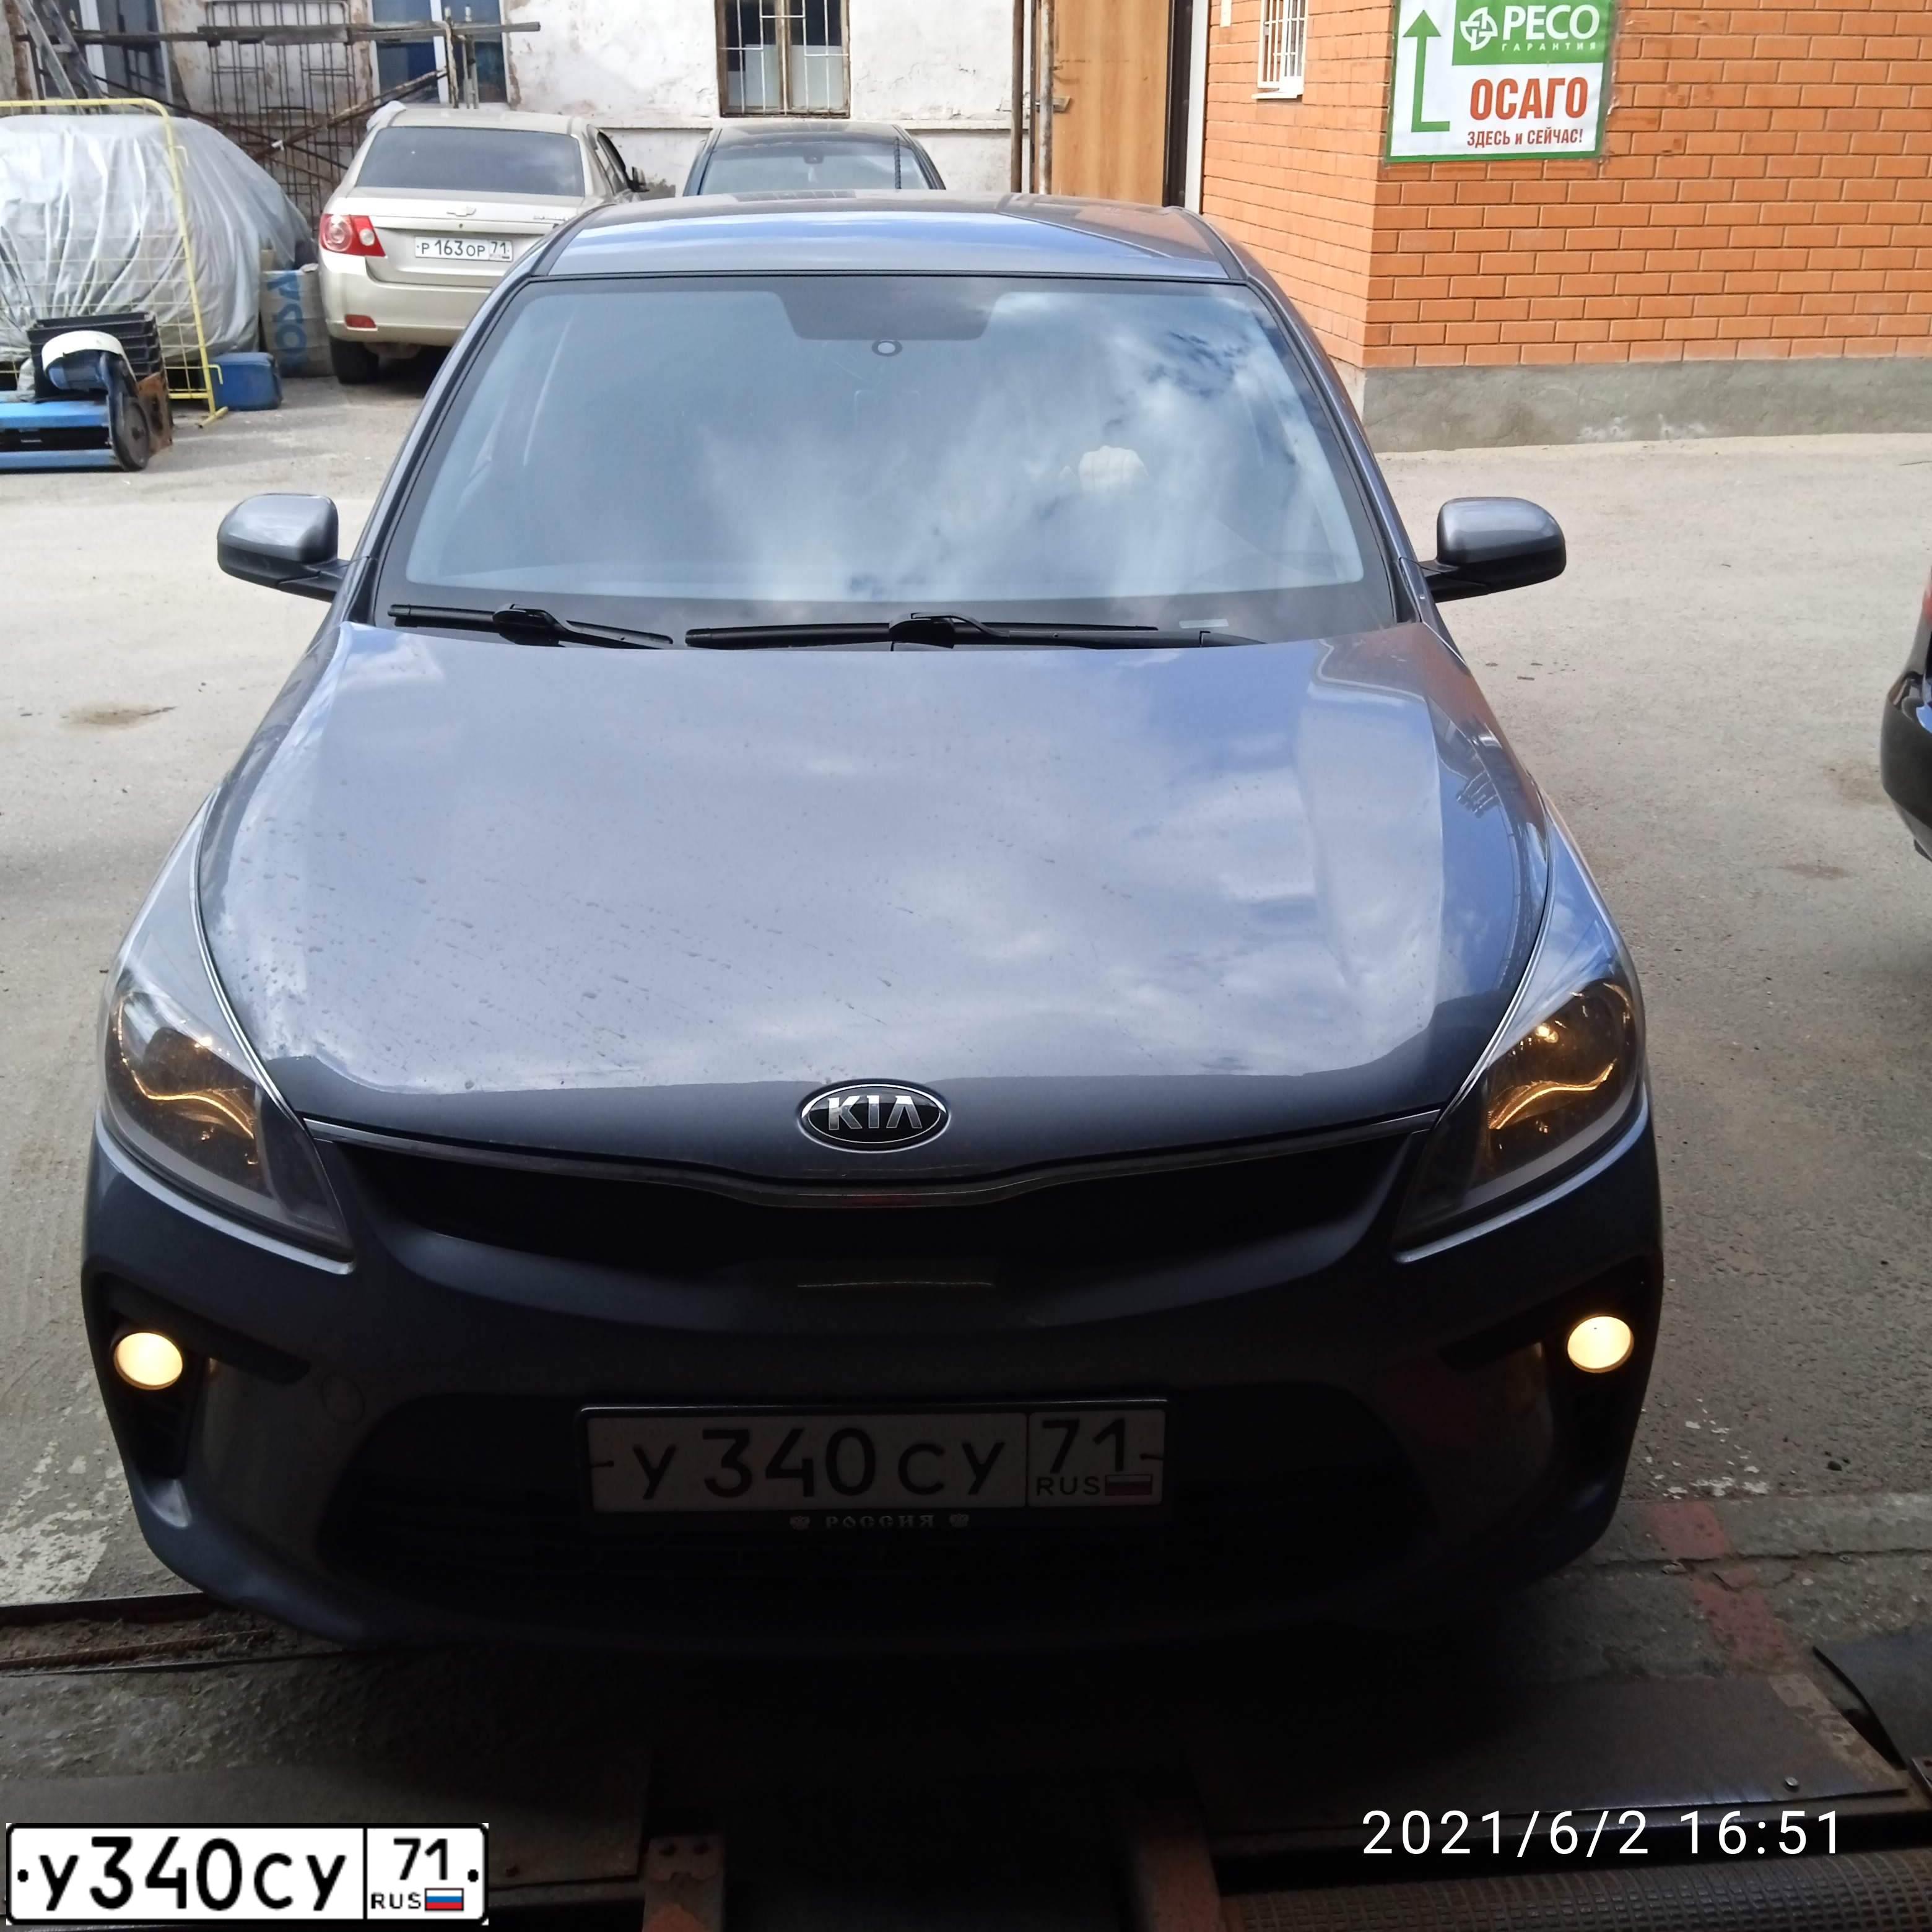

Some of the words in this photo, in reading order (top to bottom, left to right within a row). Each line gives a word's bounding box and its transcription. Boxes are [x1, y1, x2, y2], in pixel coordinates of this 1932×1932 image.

[1503, 4, 1600, 40] РЕСО
[1502, 42, 1596, 52] ГАРАНТИЯ
[1470, 77, 1588, 120] ОСАГО
[1467, 131, 1510, 149] ЗДЕСЬ
[1527, 127, 1583, 144] СЕЙЧАС!
[491, 241, 506, 255] 71
[827, 1095, 923, 1130] KIA
[1041, 1417, 1128, 1474] 71
[1037, 1476, 1102, 1496] RUS
[825, 1513, 935, 1529] РОССИЯ
